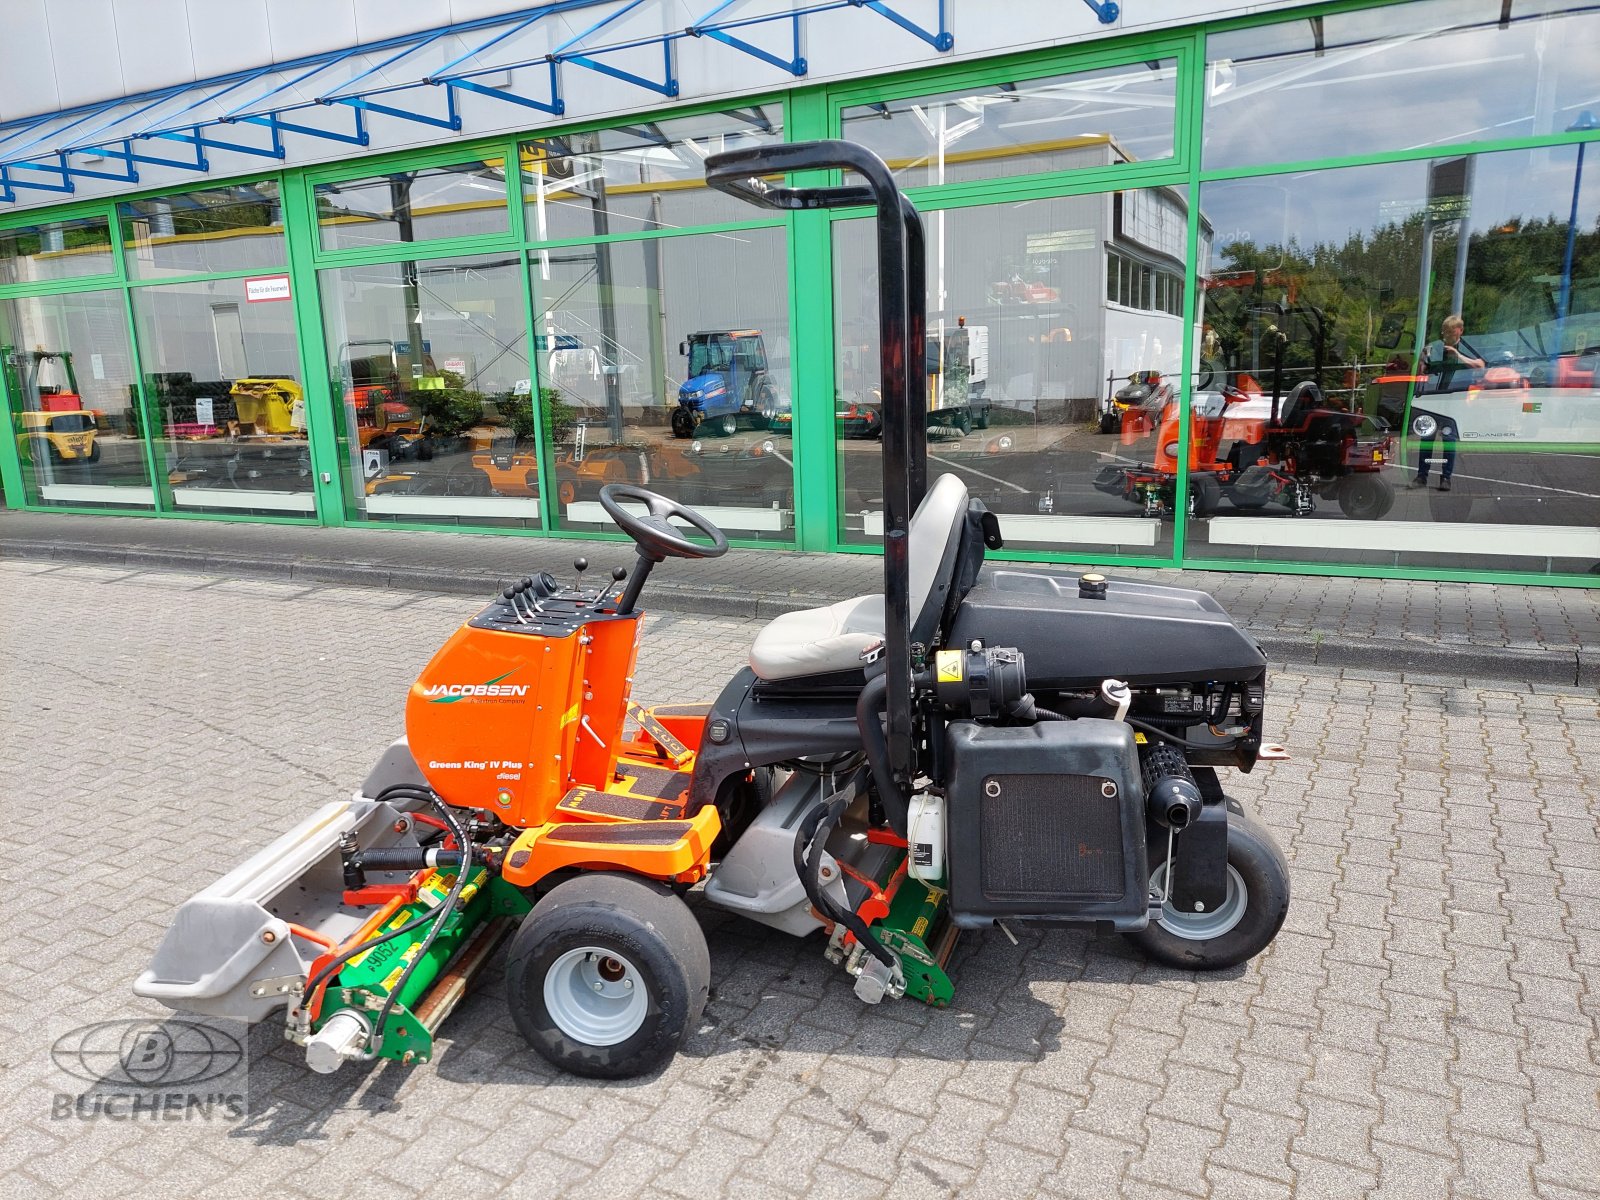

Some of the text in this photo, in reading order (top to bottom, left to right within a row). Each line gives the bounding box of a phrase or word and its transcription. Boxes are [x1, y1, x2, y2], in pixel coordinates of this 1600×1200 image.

[423, 684, 528, 696] JACOBSEN
[429, 761, 462, 769] Greens
[489, 761, 501, 769] IV
[502, 761, 523, 769] Plus
[496, 772, 521, 780] diesel
[568, 790, 588, 807] MOW
[657, 806, 674, 820] IFT
